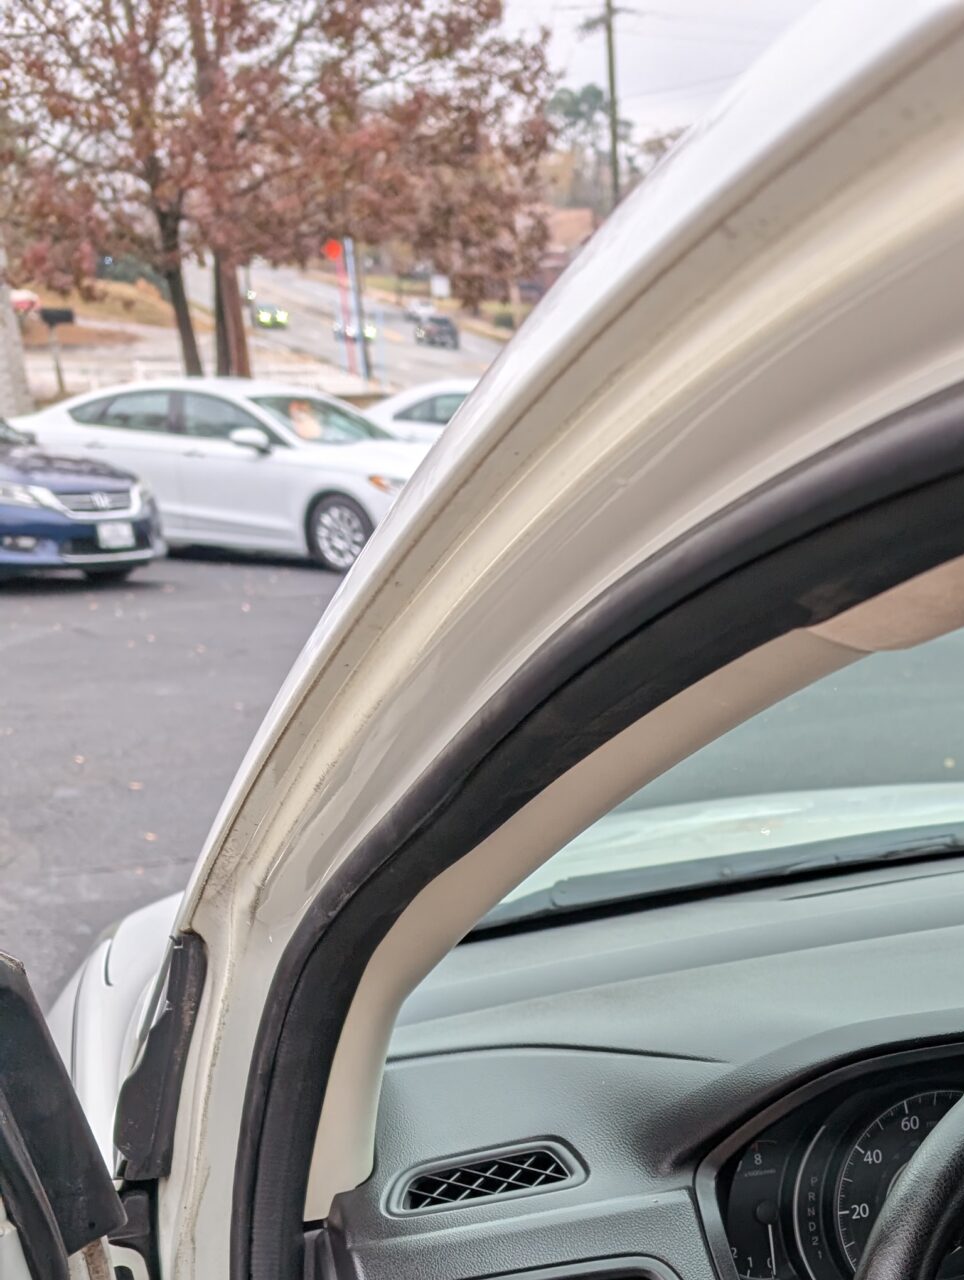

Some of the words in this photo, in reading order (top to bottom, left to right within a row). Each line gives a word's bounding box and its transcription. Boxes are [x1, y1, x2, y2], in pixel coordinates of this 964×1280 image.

[900, 1115, 920, 1132] 60
[753, 1152, 763, 1165] 8
[863, 1148, 883, 1165] 40
[810, 1176, 818, 1187] P
[808, 1191, 816, 1201] R
[807, 1207, 816, 1217] N
[850, 1202, 870, 1220] 20
[808, 1222, 816, 1232] D
[811, 1236, 819, 1246] 2
